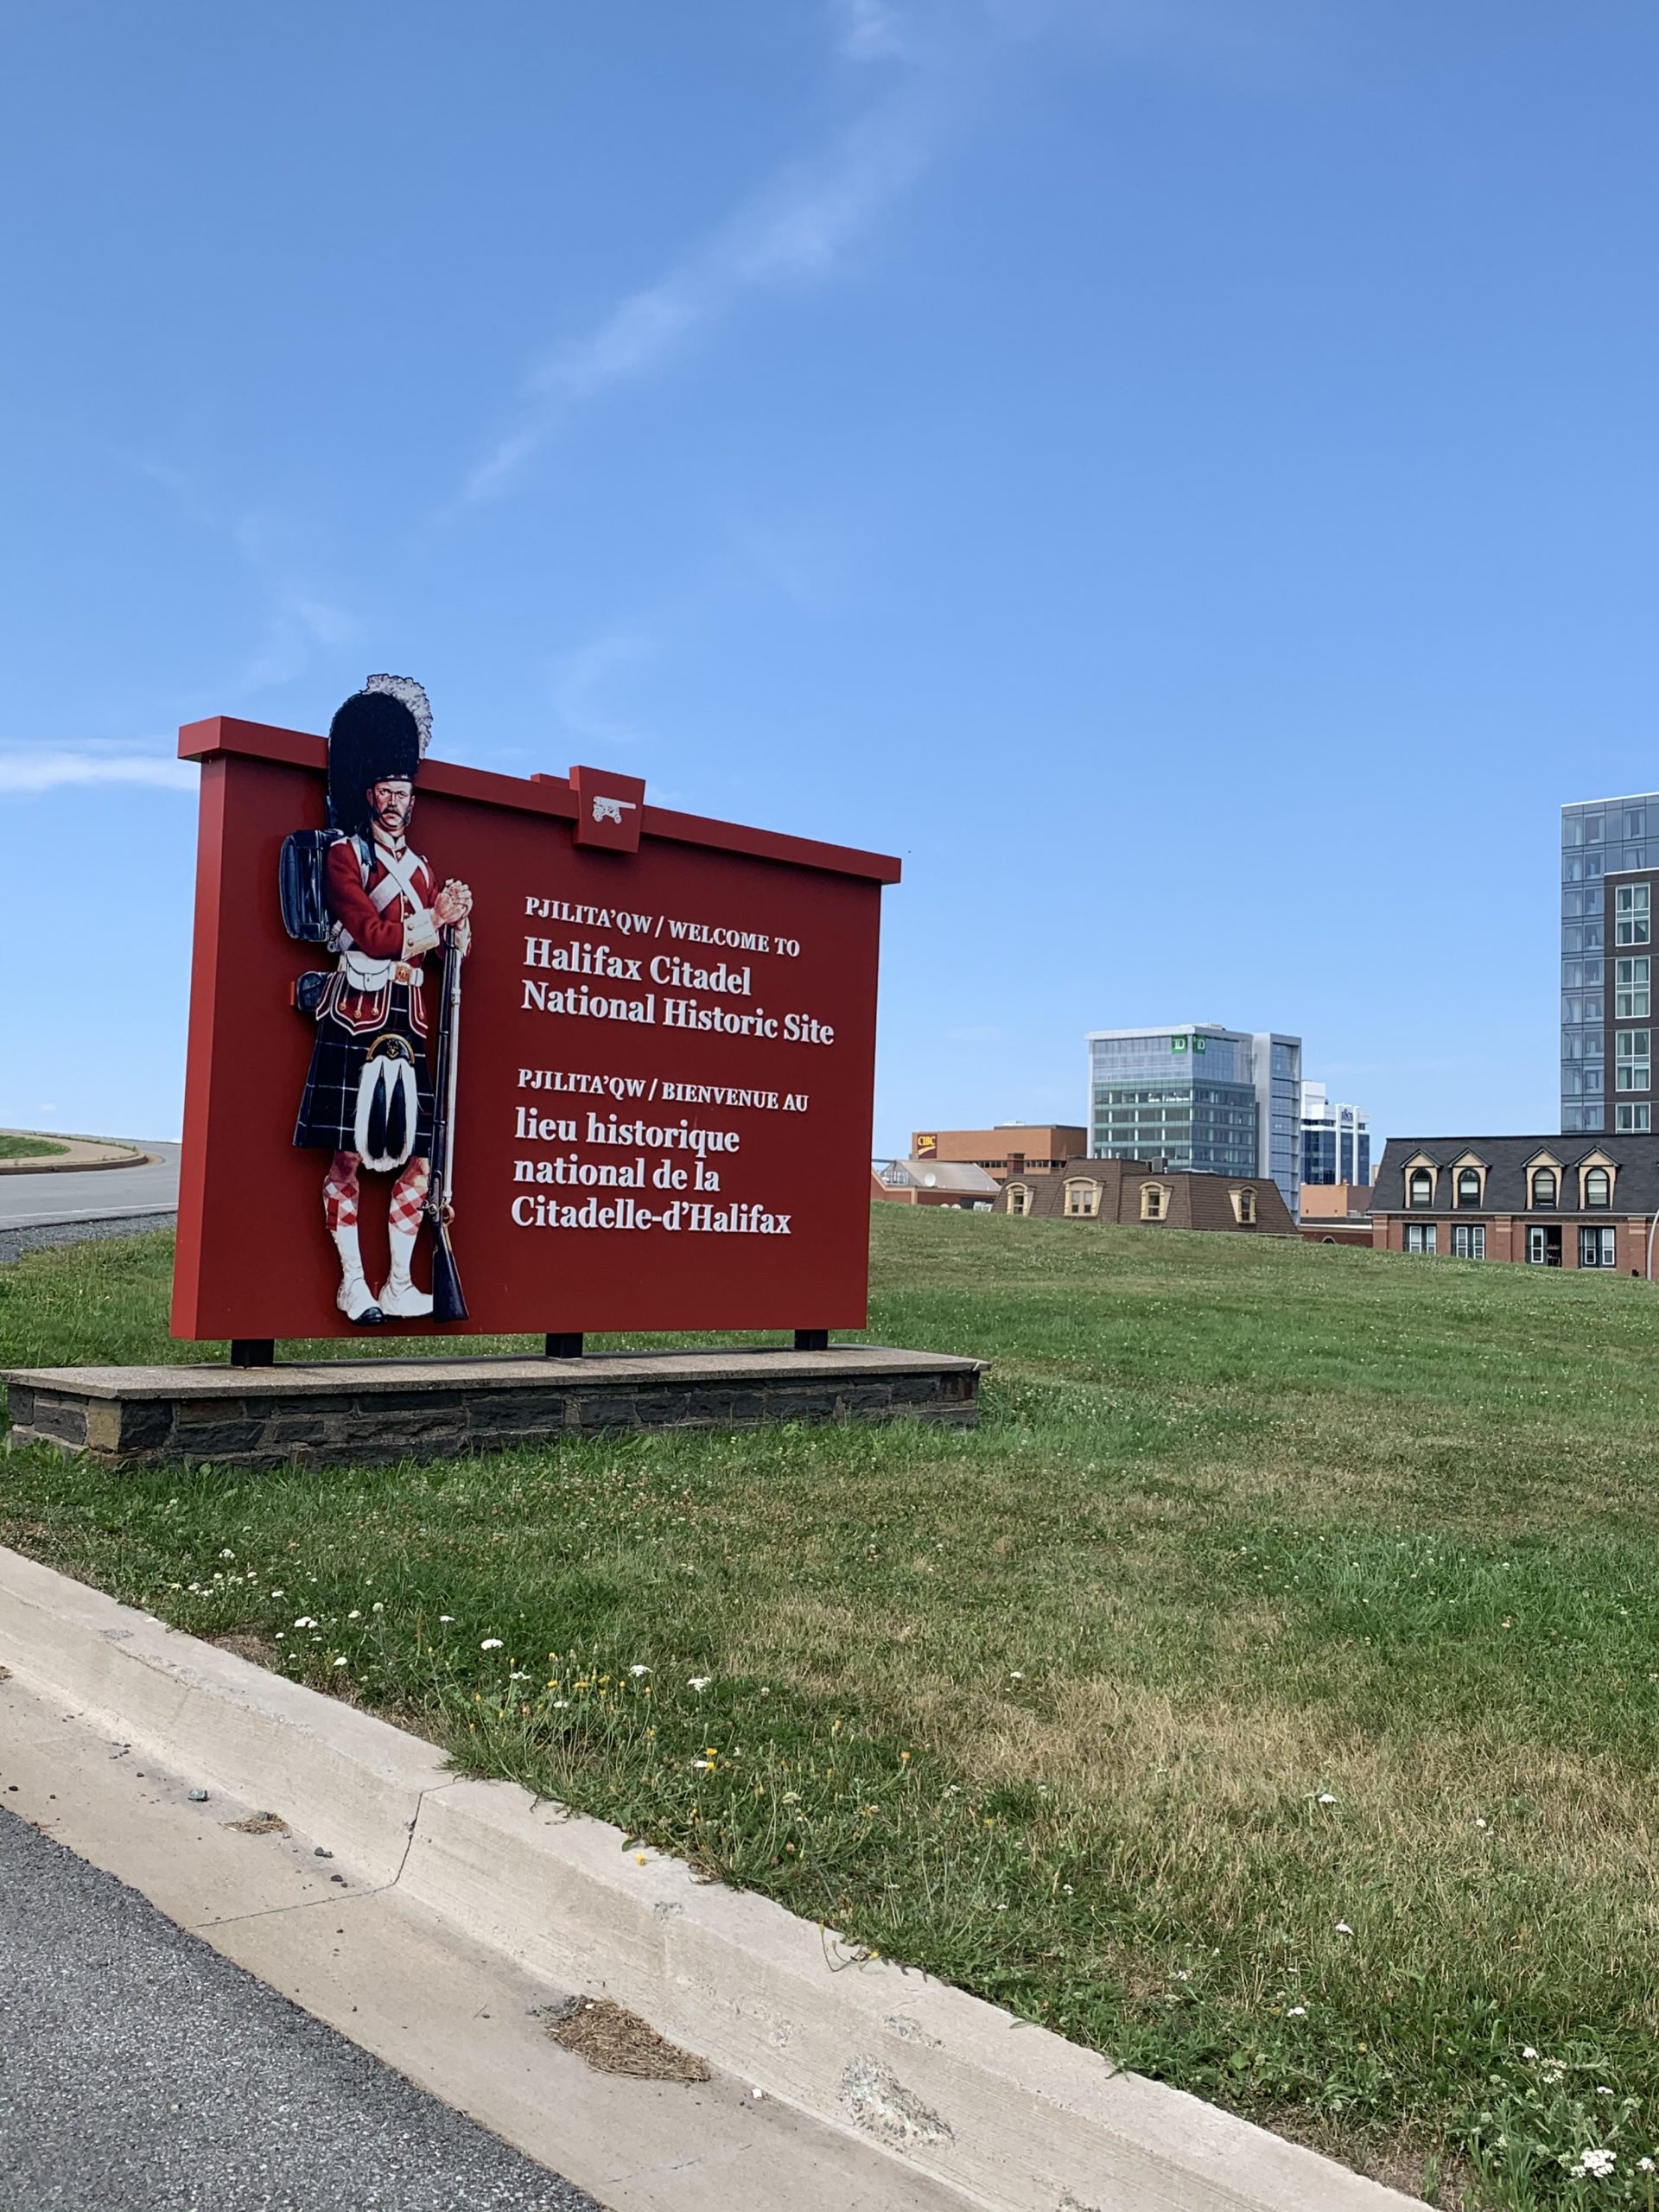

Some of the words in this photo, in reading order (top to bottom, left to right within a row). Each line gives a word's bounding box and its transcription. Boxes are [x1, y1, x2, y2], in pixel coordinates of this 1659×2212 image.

[668, 919, 770, 953] WELCOME
[774, 937, 800, 957] TO
[523, 936, 643, 982] Halifax
[650, 955, 752, 996] Citadel
[520, 979, 656, 1025] National
[662, 997, 779, 1039] Historic
[783, 1014, 835, 1046] Site
[661, 1081, 779, 1109] BIENVENUE
[782, 1093, 810, 1112] AU
[514, 1106, 578, 1141] lieu
[585, 1111, 741, 1159] historique
[918, 1135, 936, 1147] CIBC
[512, 1153, 645, 1188] national
[652, 1159, 688, 1191] de
[693, 1160, 721, 1192] la
